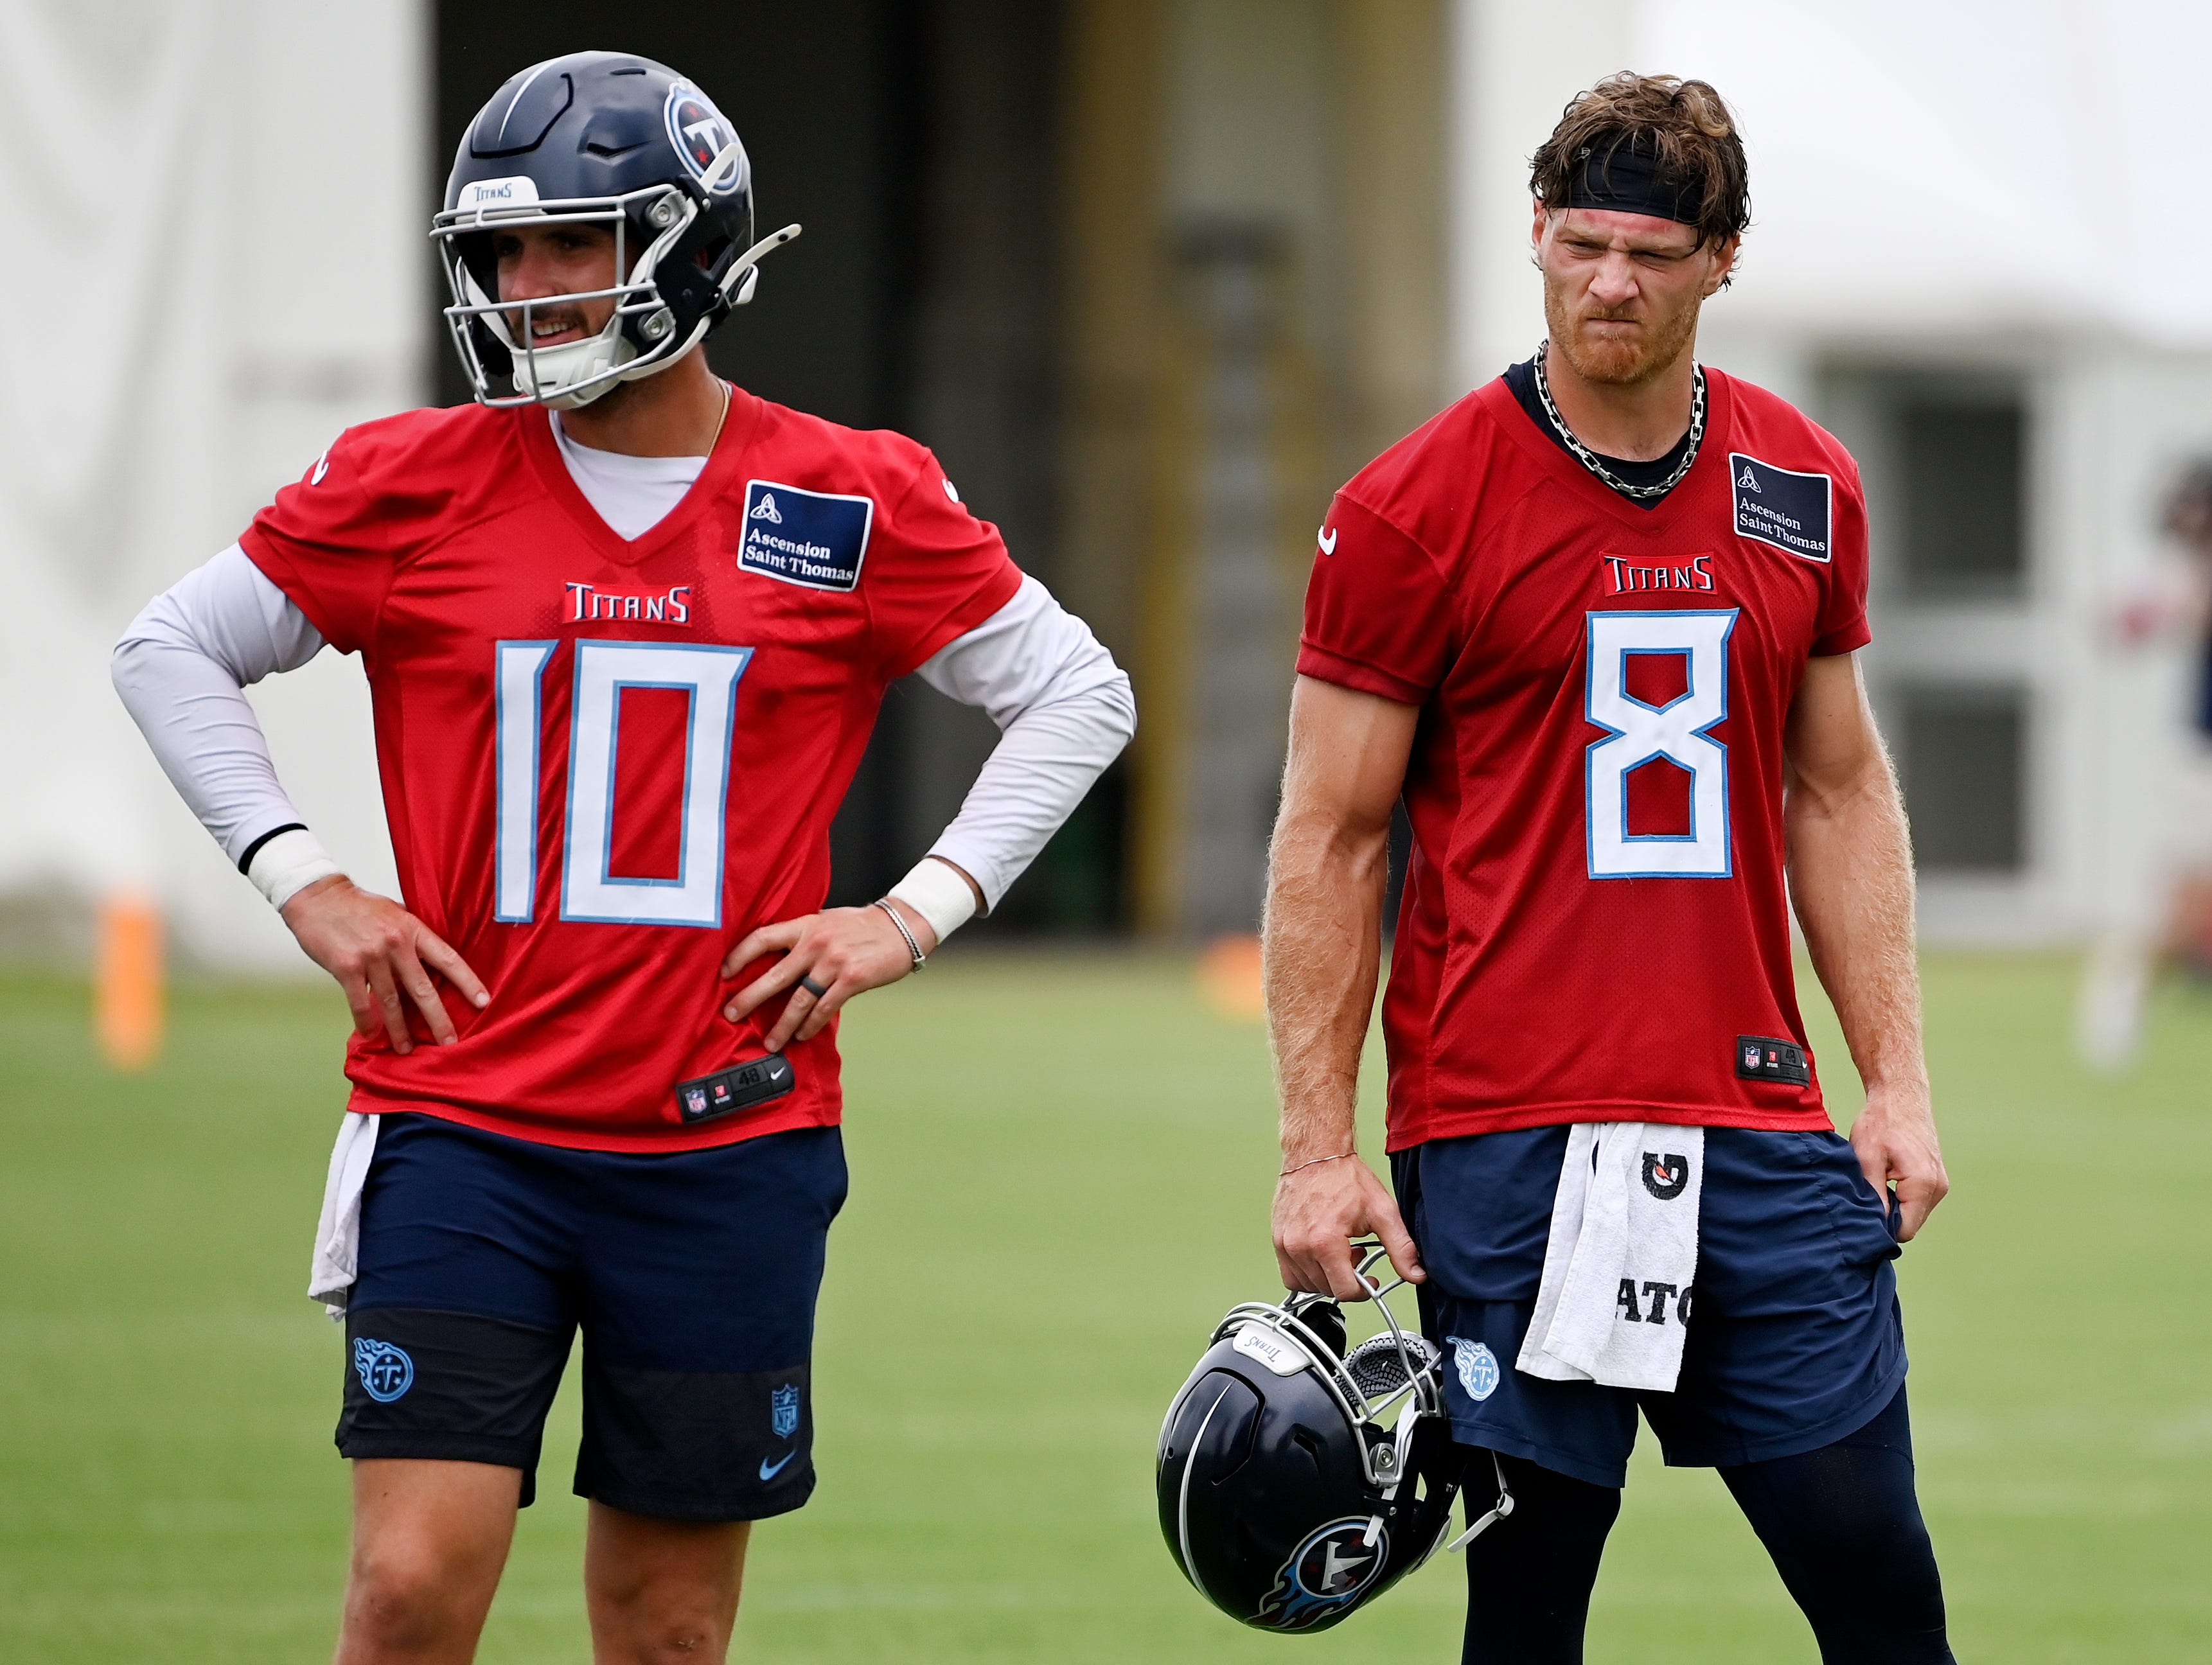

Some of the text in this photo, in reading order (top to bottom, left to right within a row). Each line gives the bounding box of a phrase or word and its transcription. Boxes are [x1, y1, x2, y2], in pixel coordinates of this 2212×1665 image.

[474, 182, 512, 202] TITANS
[1739, 497, 1801, 530] Ascension
[747, 527, 831, 560] Ascension
[1740, 513, 1825, 551] Saint Thomas
[745, 545, 854, 581] Saint Thomas
[1604, 556, 1714, 592] TITANS
[565, 581, 691, 623] TITANS
[1585, 607, 1740, 880] 8
[493, 637, 756, 929] 10
[1244, 1336, 1282, 1362] TITANS
